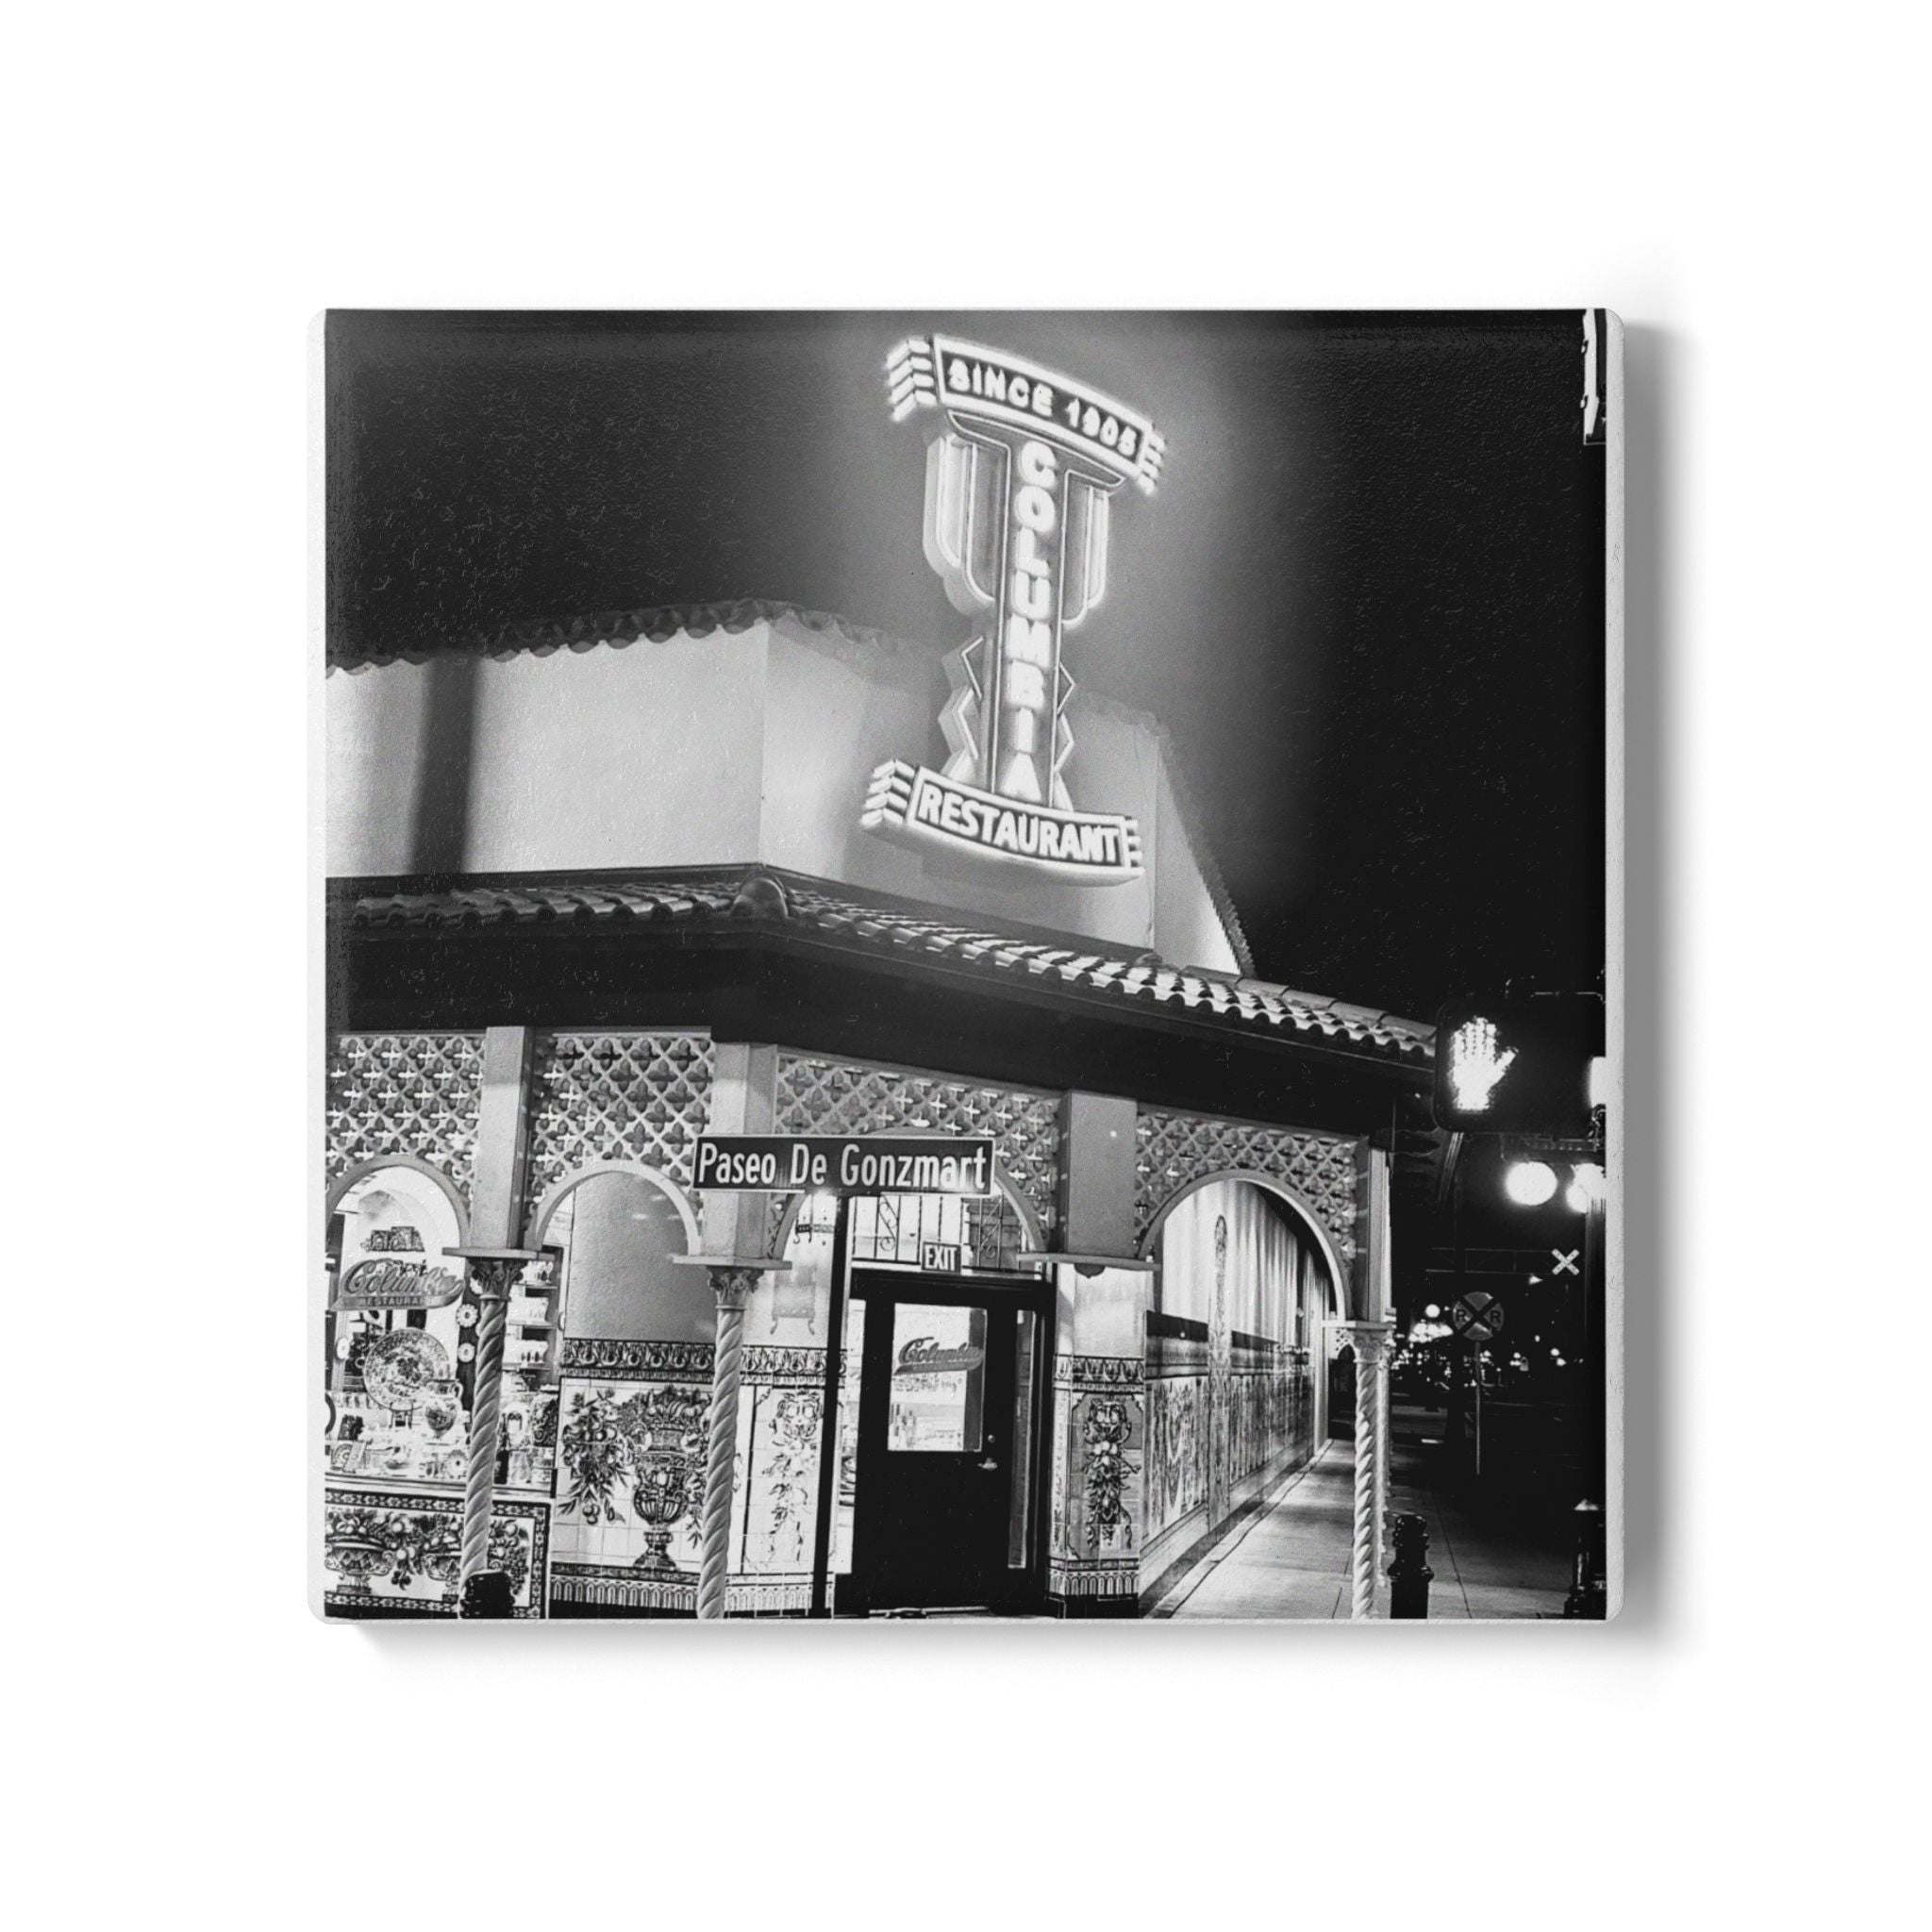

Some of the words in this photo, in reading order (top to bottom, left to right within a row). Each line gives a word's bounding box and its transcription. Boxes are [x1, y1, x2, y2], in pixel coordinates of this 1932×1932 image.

[949, 358, 1053, 417] SINCE
[1065, 398, 1138, 457] 1905
[1000, 441, 1058, 803] COLUMBIA
[919, 783, 1120, 863] RESTAURANT
[698, 1142, 776, 1185] Paseo
[790, 1142, 827, 1186] De
[841, 1143, 987, 1190] Gonzmart
[924, 1244, 958, 1271] EXIT
